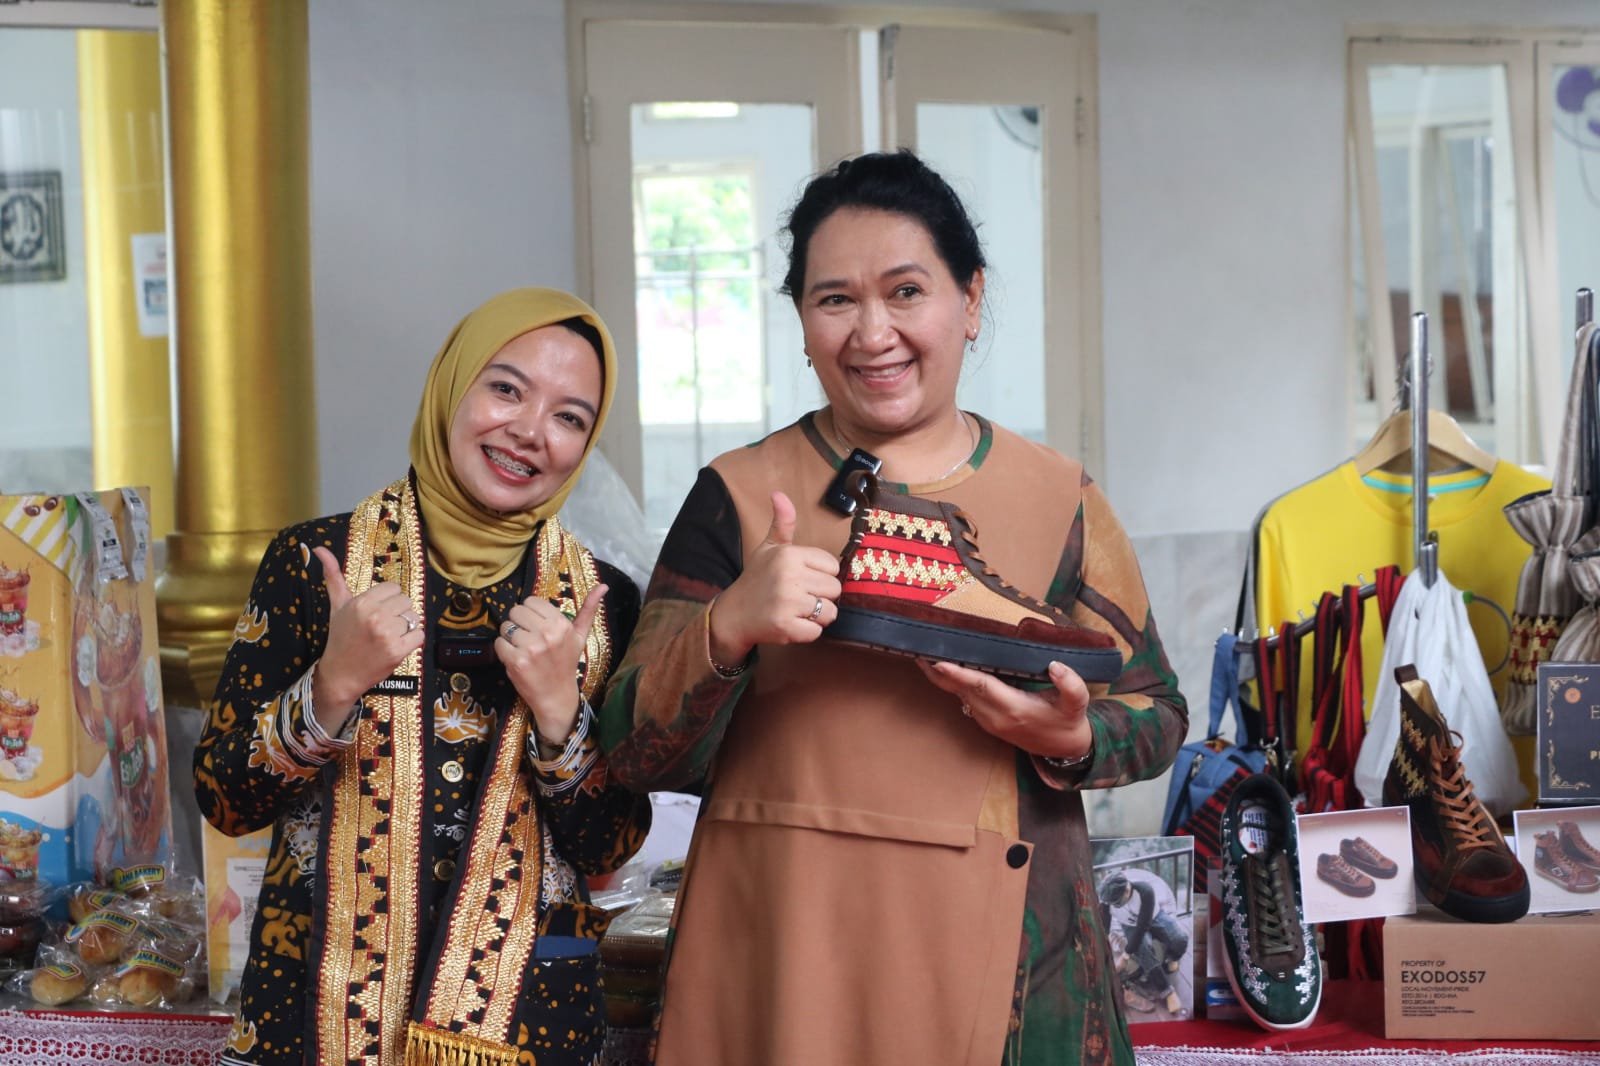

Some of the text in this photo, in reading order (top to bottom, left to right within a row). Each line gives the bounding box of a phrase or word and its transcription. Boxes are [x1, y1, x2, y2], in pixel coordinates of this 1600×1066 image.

[379, 680, 414, 690] KUSNALI
[1401, 960, 1434, 968] PROPERTY
[1401, 970, 1486, 984] EXODOS57
